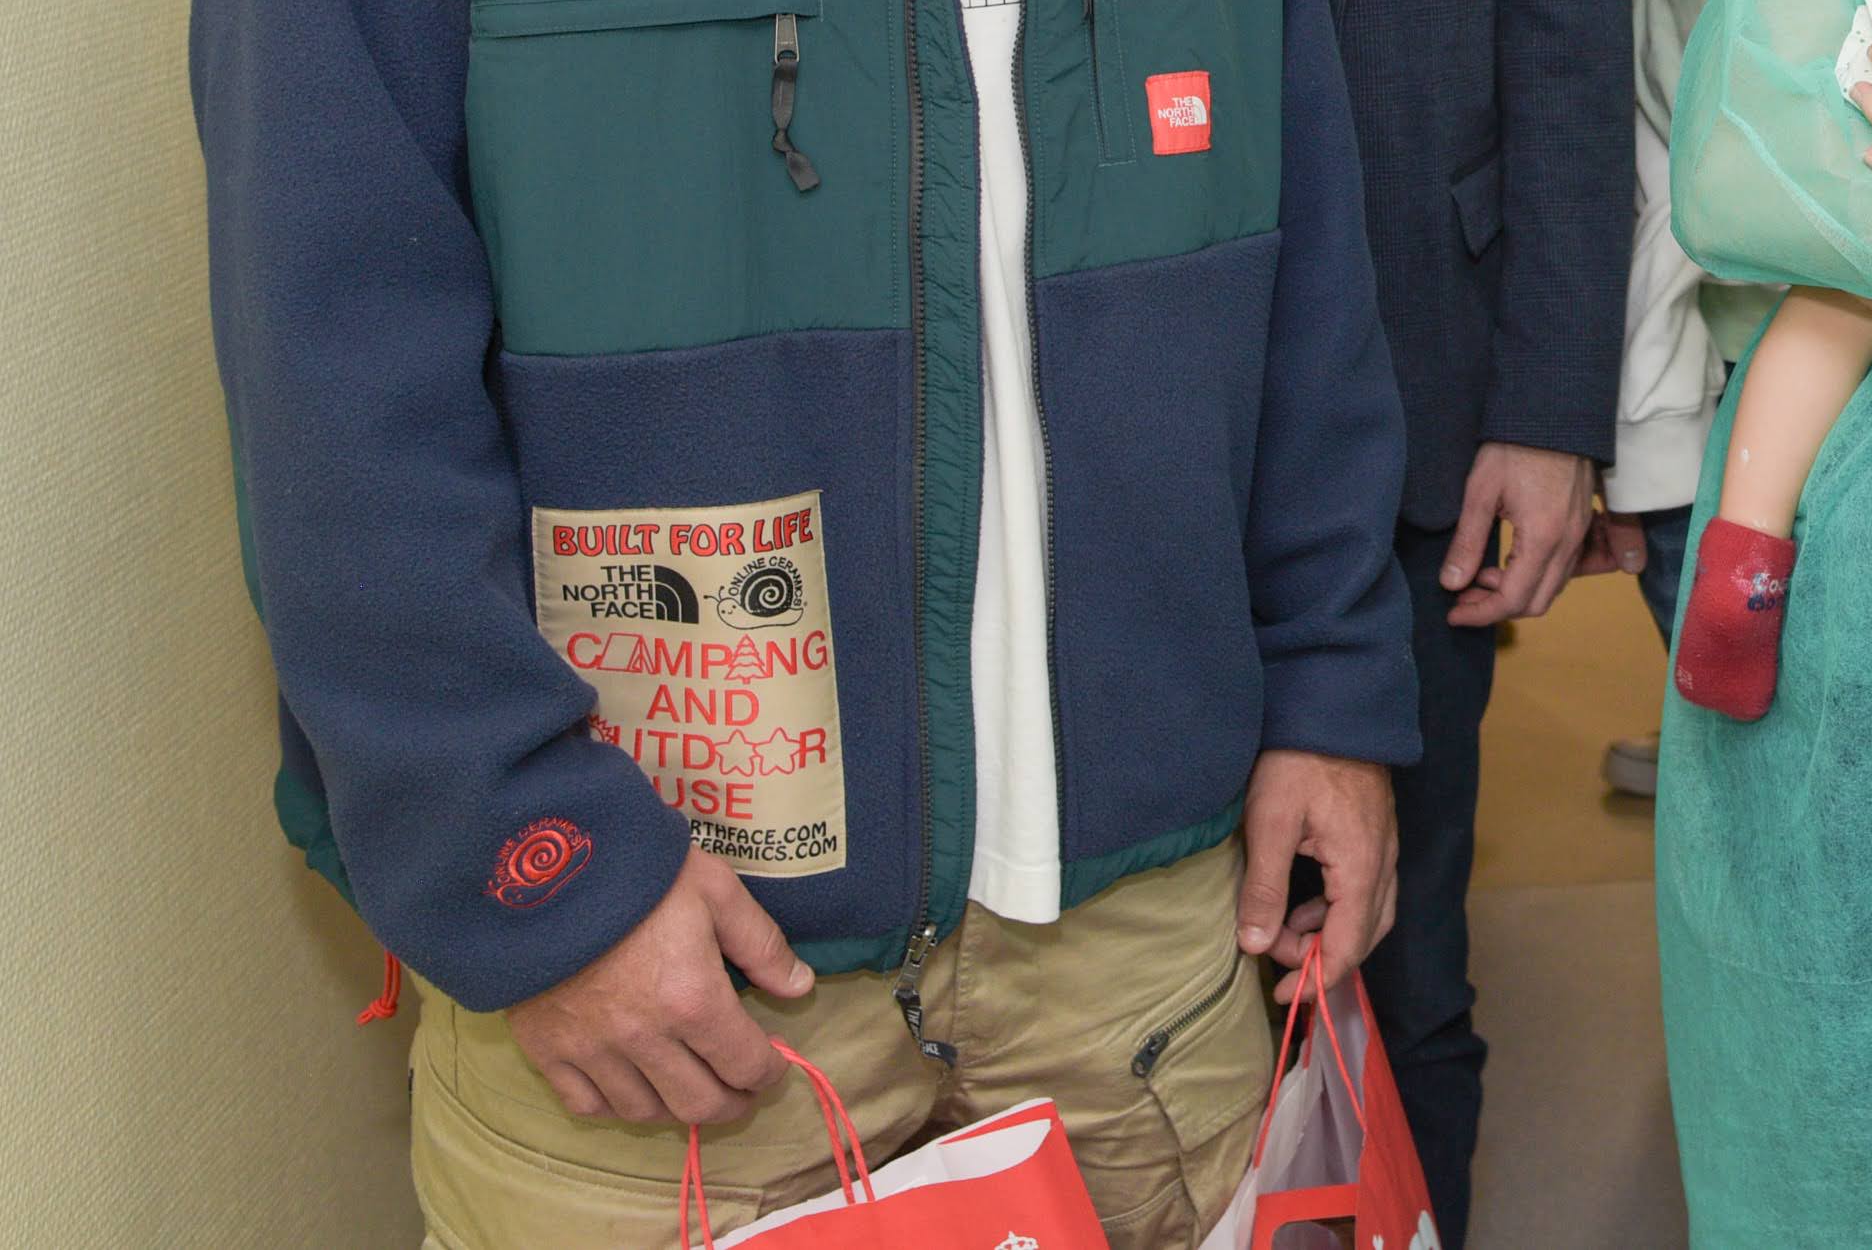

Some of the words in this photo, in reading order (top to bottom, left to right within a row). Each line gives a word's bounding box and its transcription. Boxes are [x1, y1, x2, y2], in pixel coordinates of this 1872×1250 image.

[1171, 96, 1193, 108] THE
[1157, 107, 1194, 119] NORTH
[1169, 116, 1195, 128] FACE
[553, 524, 660, 557] BUILT
[669, 523, 745, 556] FOR
[753, 508, 814, 553] LIFE
[600, 565, 651, 582] THE
[728, 558, 766, 597] ONLINE
[769, 556, 803, 606] CERAMICS
[563, 584, 652, 601] NORTH
[591, 602, 655, 620] FACE
[646, 684, 760, 727] AND
